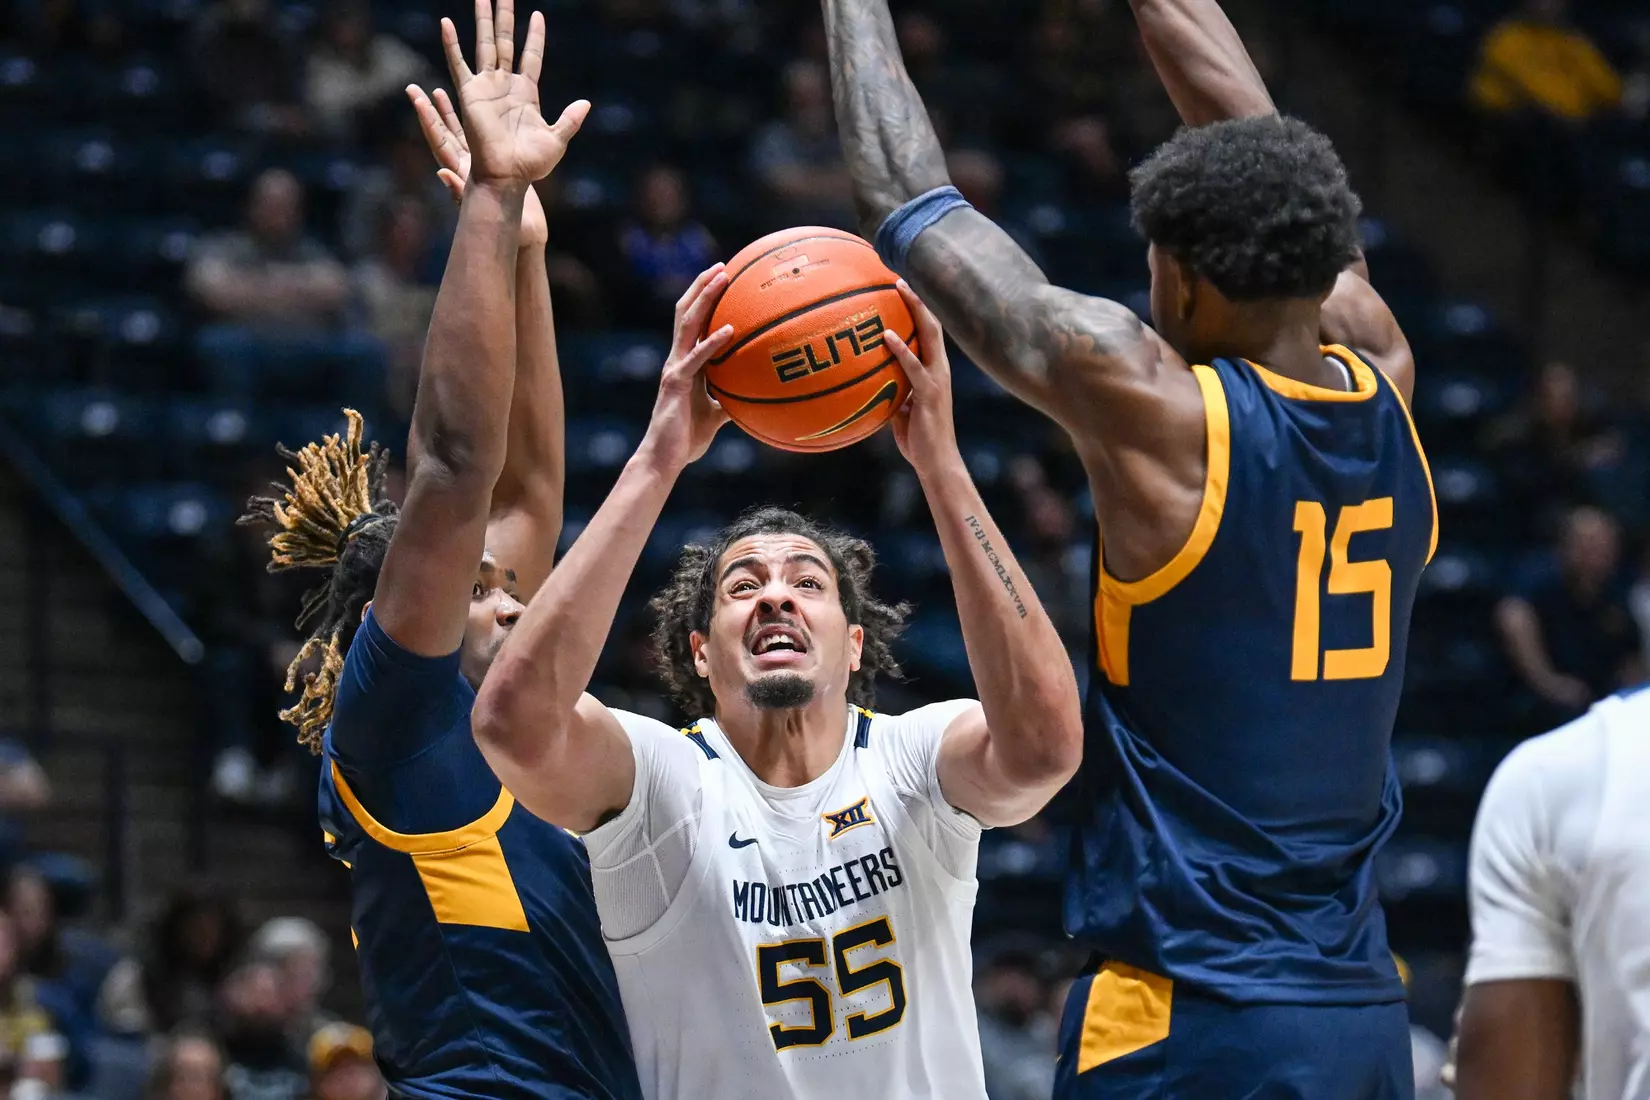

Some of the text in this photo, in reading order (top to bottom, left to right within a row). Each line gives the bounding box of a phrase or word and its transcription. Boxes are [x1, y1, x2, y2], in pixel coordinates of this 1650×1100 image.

[771, 314, 885, 383] ELITE
[1291, 496, 1393, 680] 15
[824, 798, 873, 839] XII
[732, 846, 903, 928] MOUNTAINEERS
[756, 915, 907, 1053] 55
